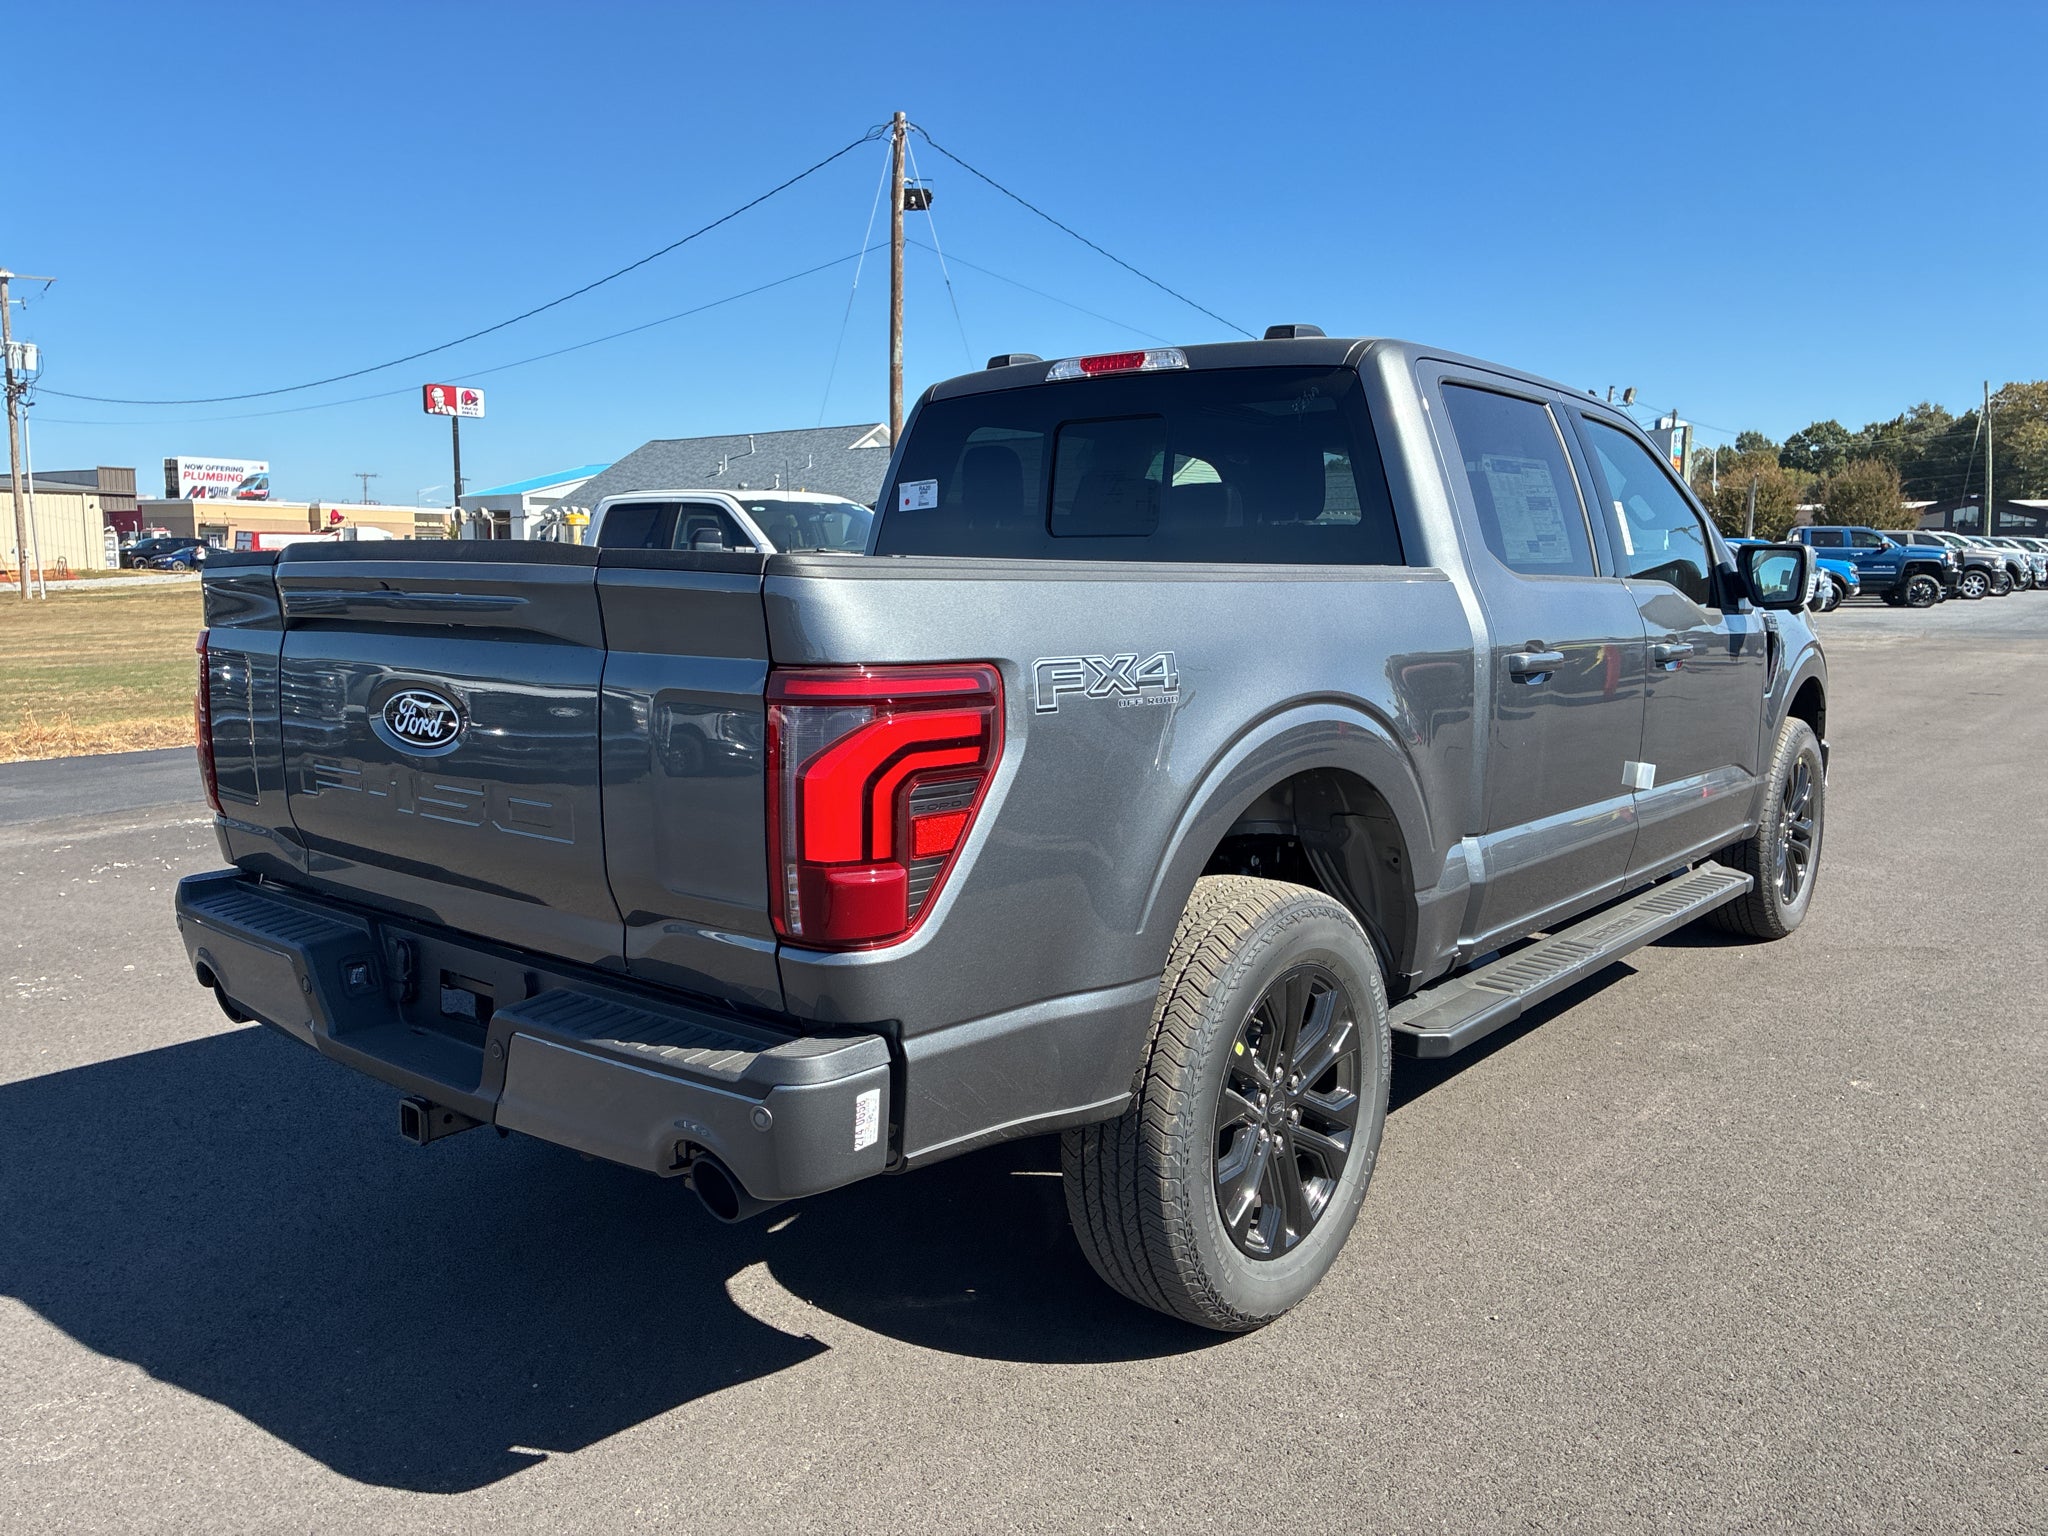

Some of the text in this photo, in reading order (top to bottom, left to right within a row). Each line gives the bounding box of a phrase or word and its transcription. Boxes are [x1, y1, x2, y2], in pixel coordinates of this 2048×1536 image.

[183, 471, 243, 483] PLUMBING
[184, 463, 204, 471] NOW
[205, 464, 244, 473] OFFERING
[1031, 651, 1180, 715] FX4
[1118, 695, 1179, 708] OFF ROAD
[394, 698, 444, 738] Ford
[299, 752, 576, 845] F-150
[913, 800, 962, 812] FORD
[1372, 985, 1390, 1083] Hankook
